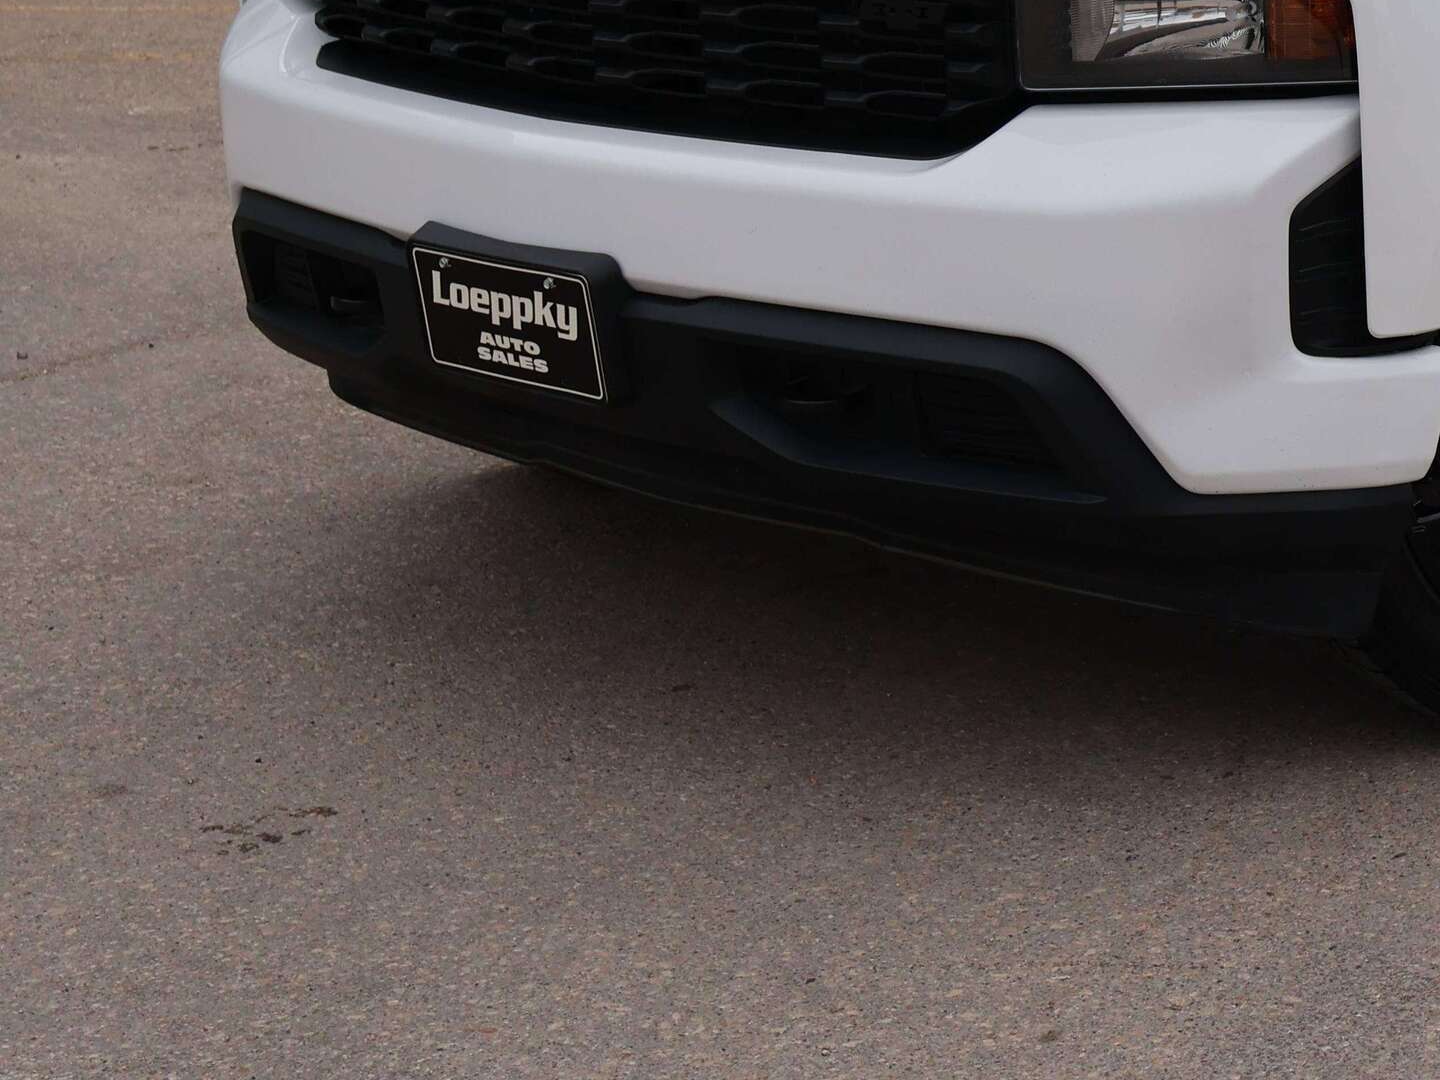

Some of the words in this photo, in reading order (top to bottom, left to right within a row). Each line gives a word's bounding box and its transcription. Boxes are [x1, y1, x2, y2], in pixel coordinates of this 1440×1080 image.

[431, 269, 578, 341] Loeppky
[480, 331, 541, 356] AUTO
[477, 346, 549, 373] SALES
